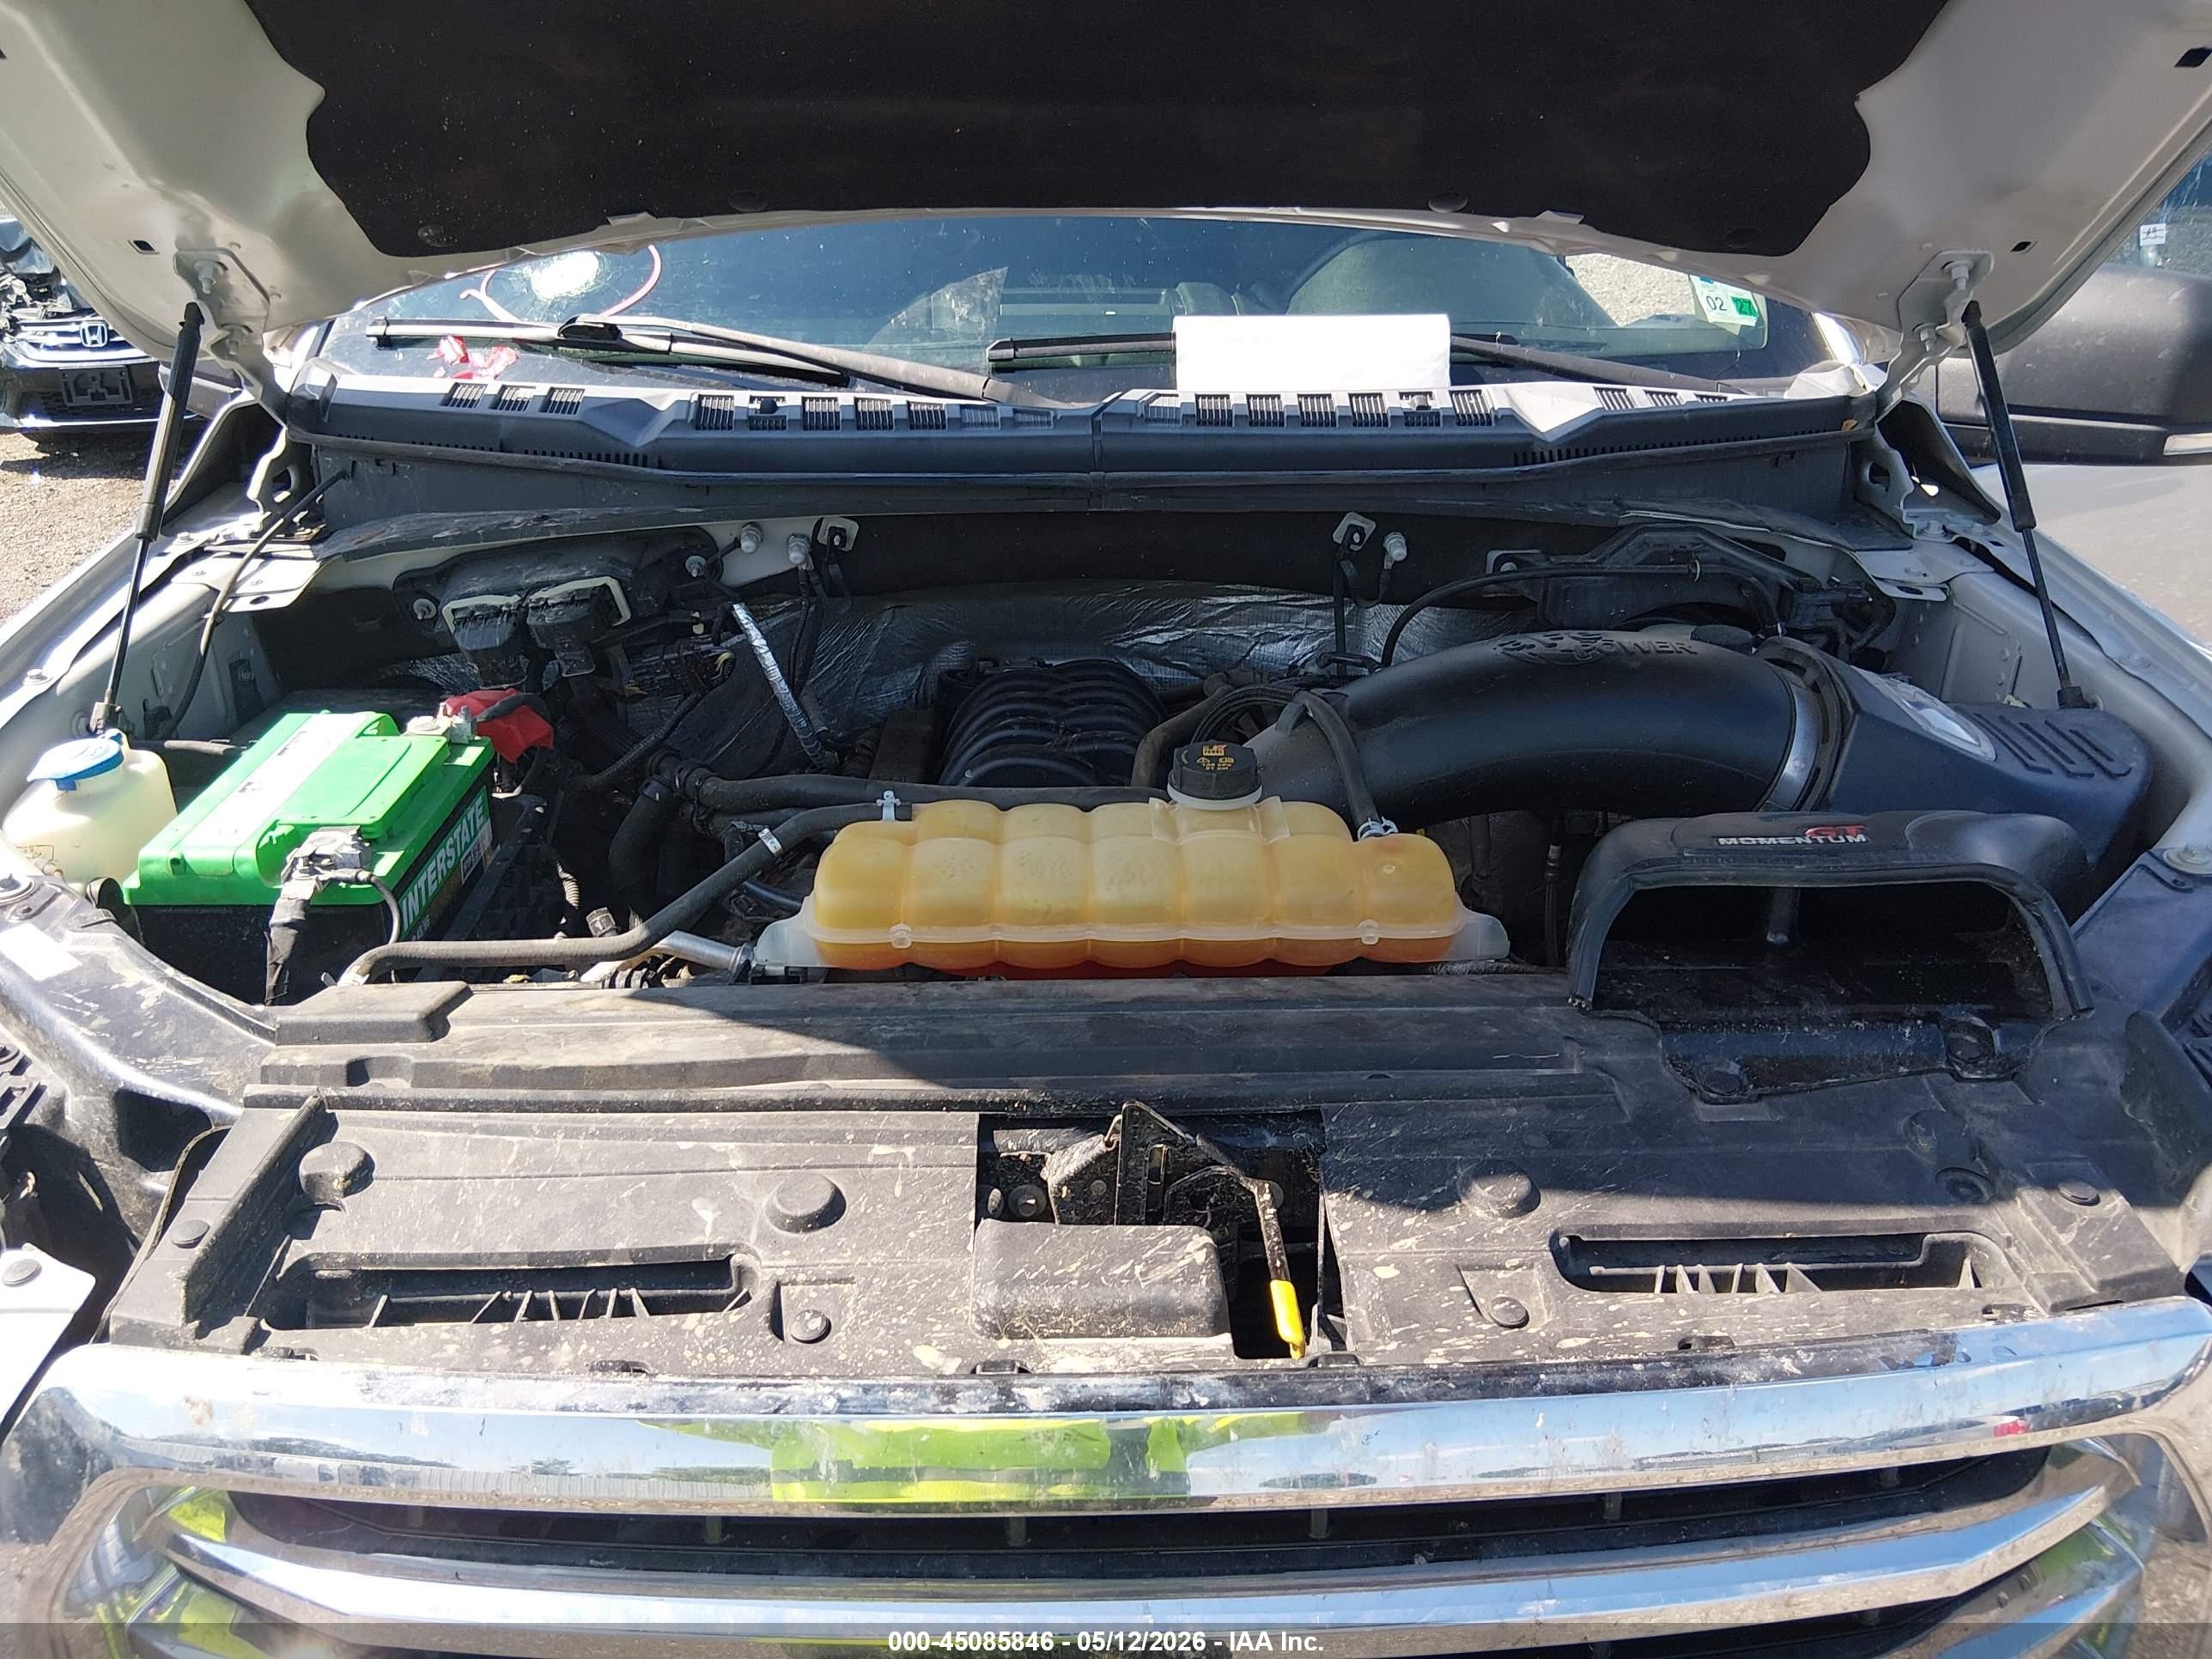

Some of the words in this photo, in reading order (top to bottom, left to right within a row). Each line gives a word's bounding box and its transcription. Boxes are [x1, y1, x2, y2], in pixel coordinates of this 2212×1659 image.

[1705, 295, 1728, 311] 02
[1735, 299, 1754, 315] 27
[1573, 639, 1698, 660] POWER
[1717, 834, 1868, 846] MOMENTUM
[1805, 824, 1867, 837] GT
[401, 795, 484, 932] INTERSTATE
